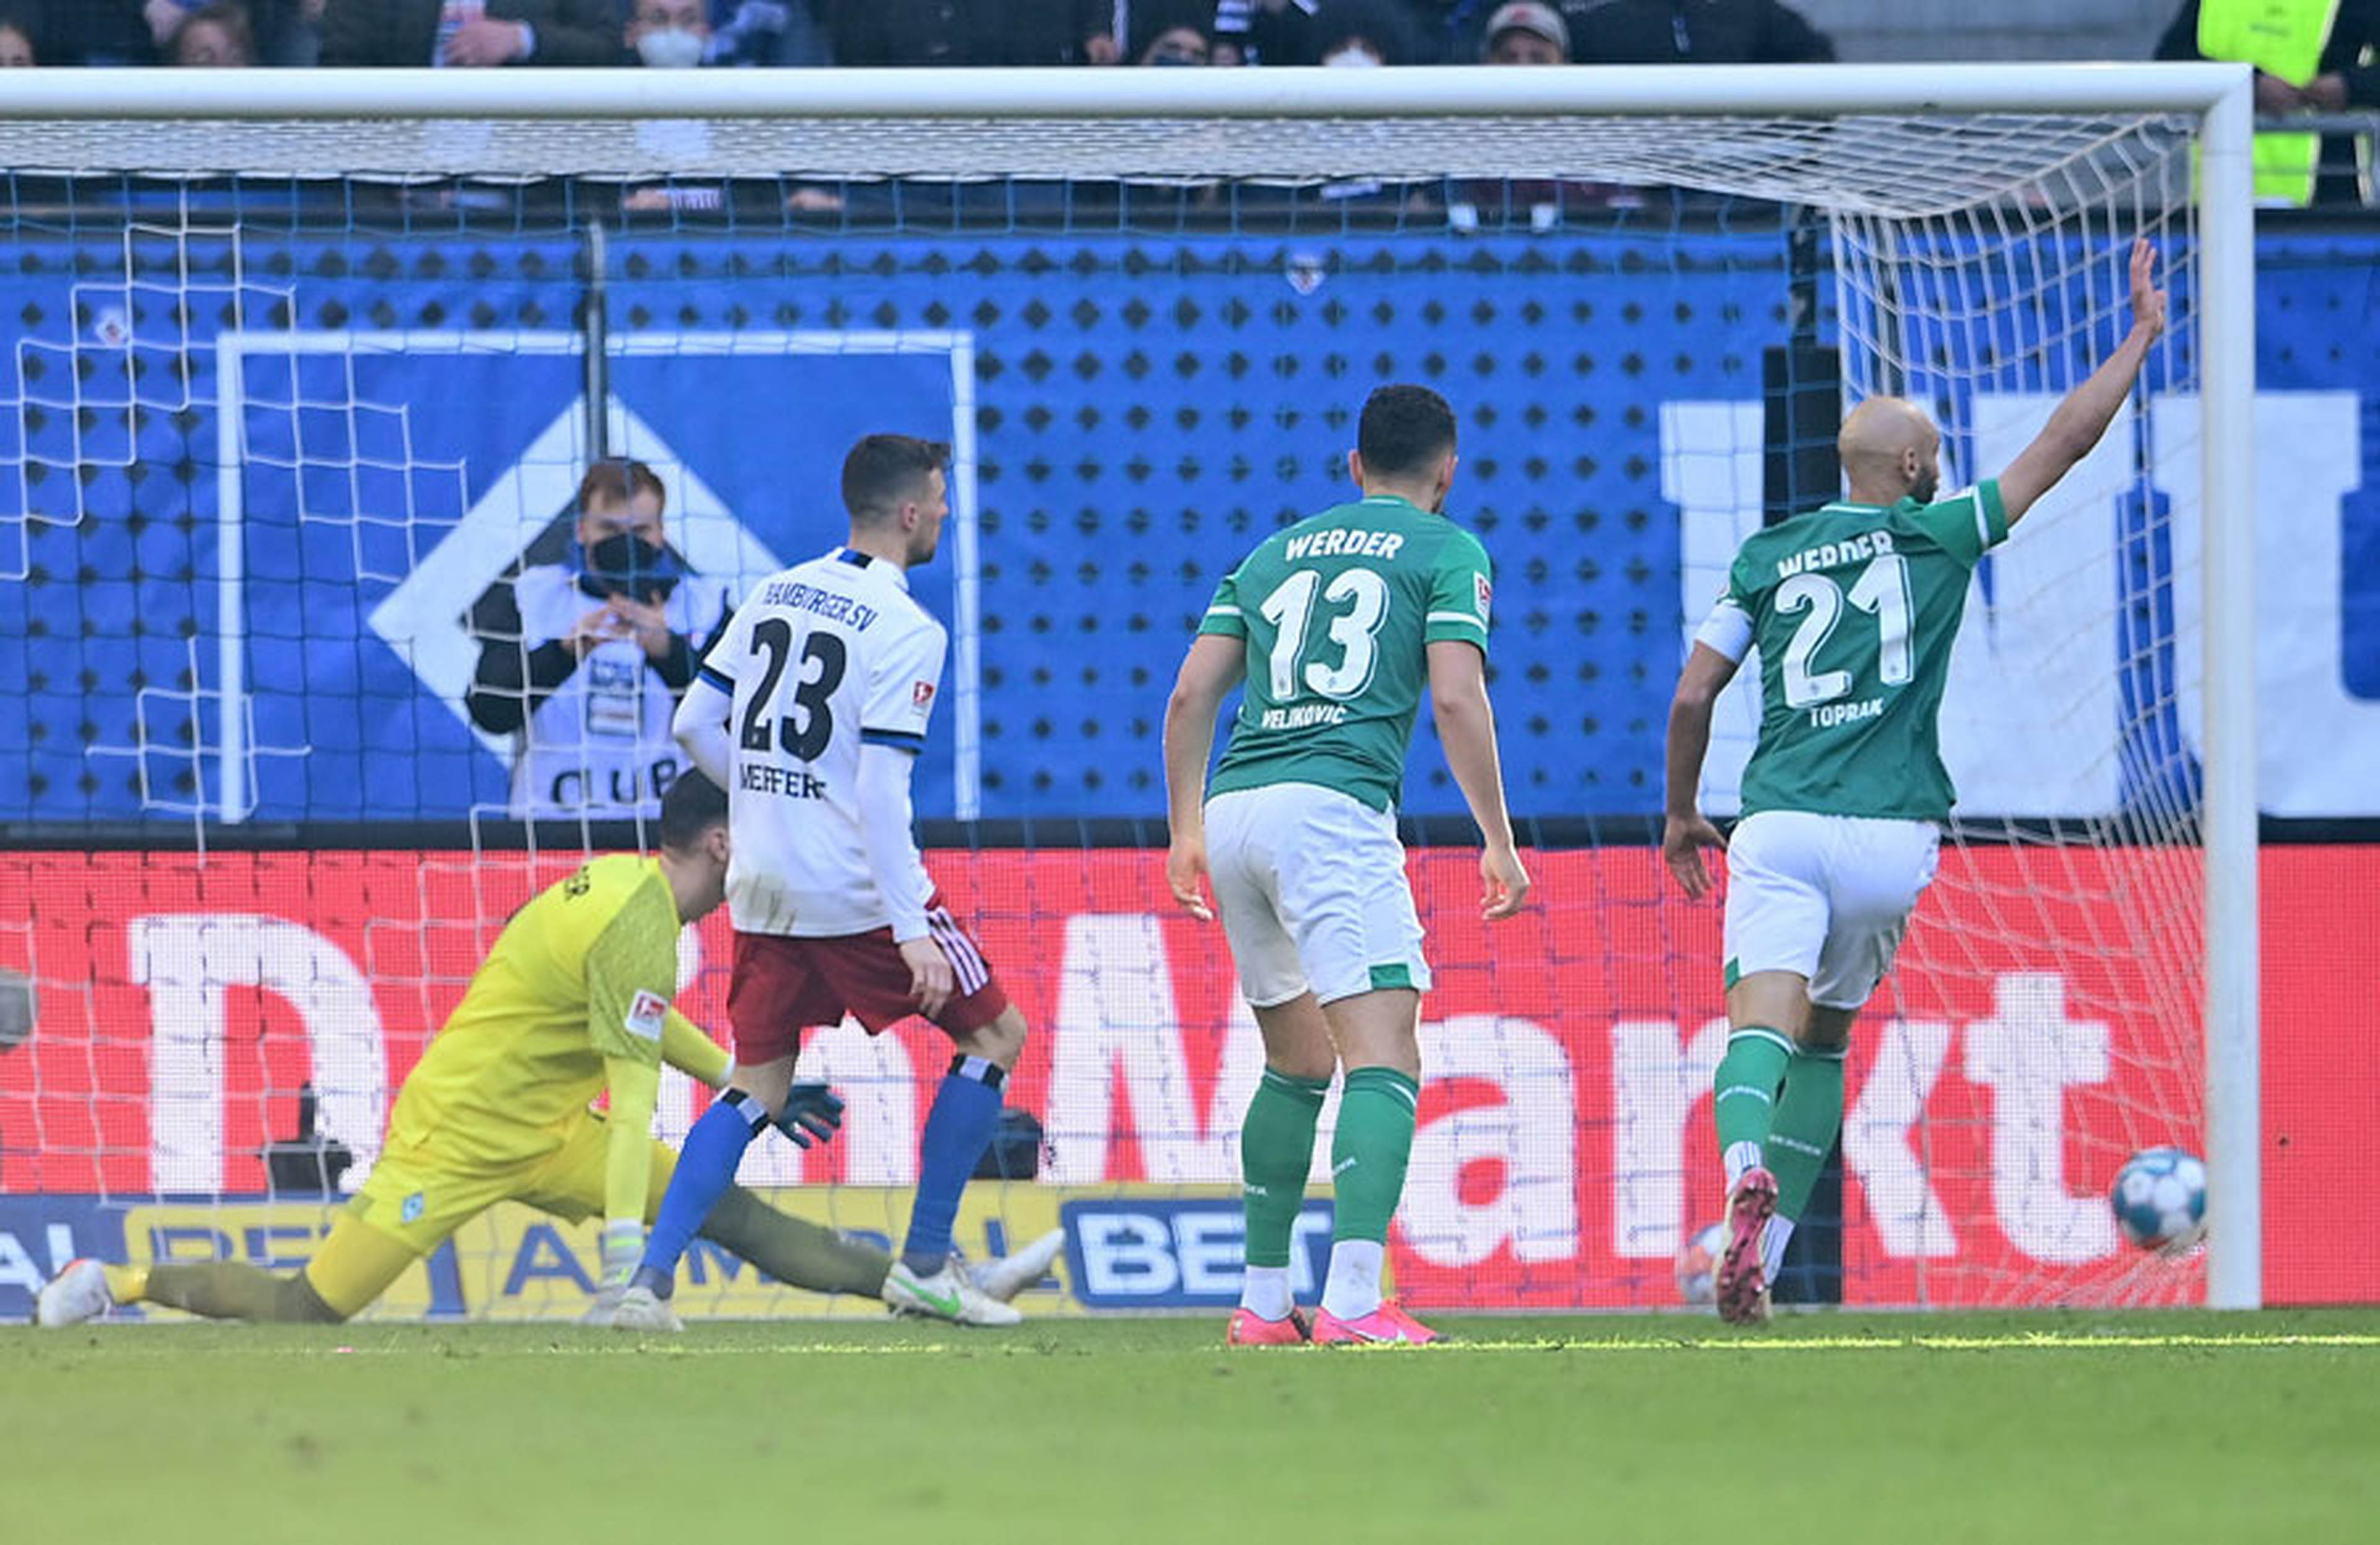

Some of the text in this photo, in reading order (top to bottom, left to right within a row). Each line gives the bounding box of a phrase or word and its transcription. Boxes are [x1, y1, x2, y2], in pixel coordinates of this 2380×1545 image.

[1286, 528, 1404, 561] WERDER
[846, 604, 878, 632] SV
[1260, 567, 1391, 702] 13
[1774, 553, 1916, 710] 21
[741, 617, 847, 764] 23
[1811, 697, 1884, 728] TOPRAK
[1077, 1212, 1333, 1295] BET
